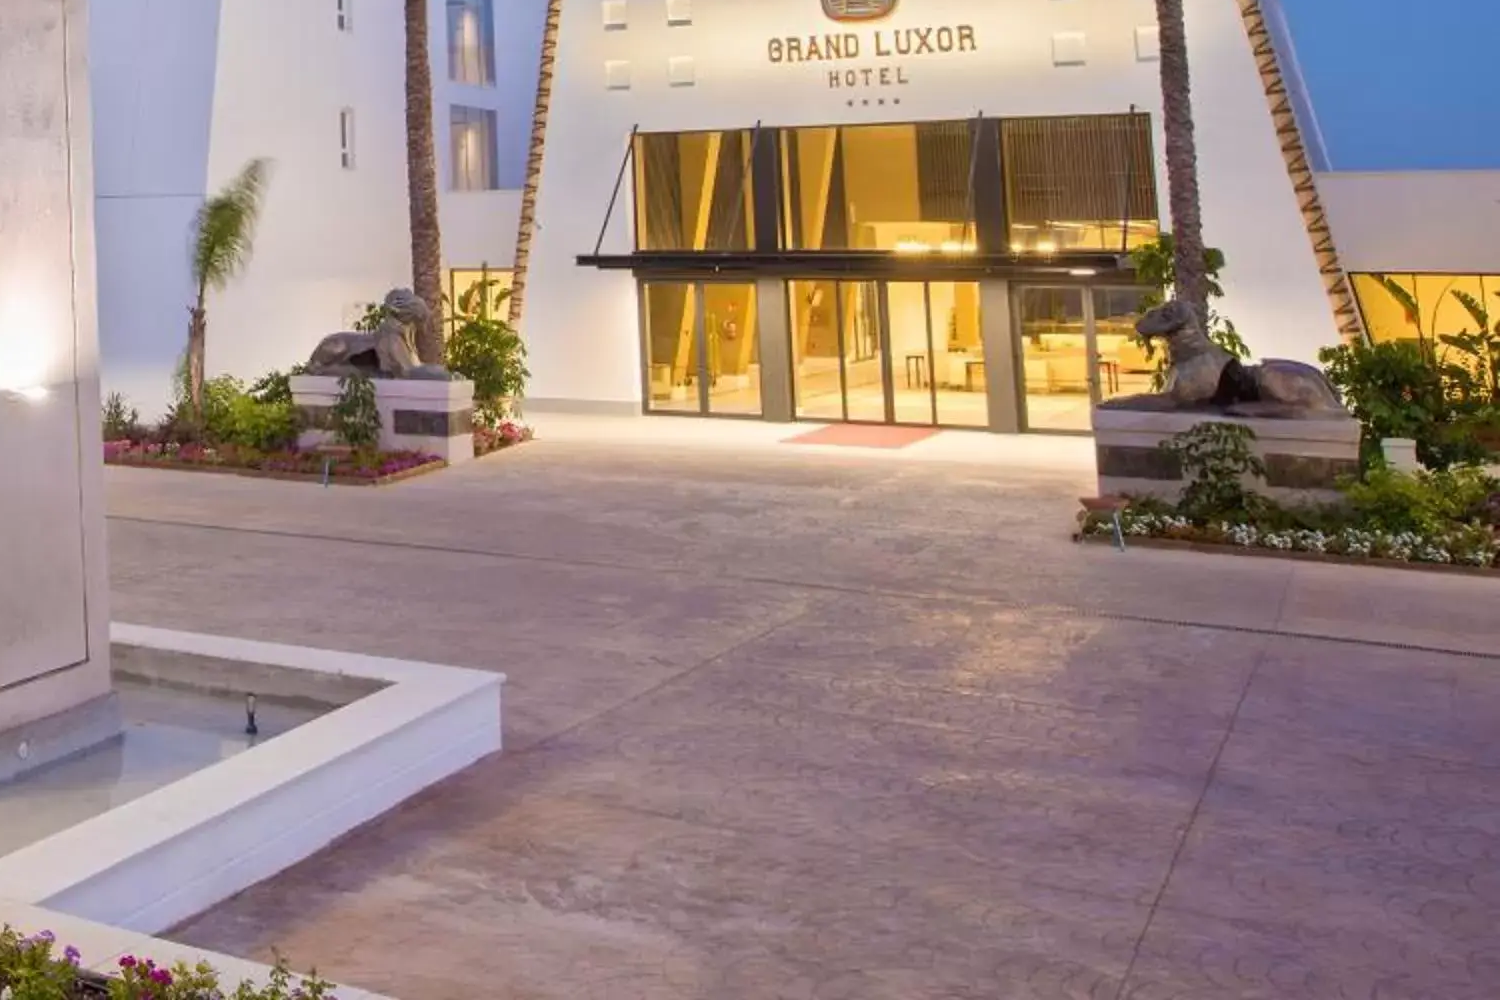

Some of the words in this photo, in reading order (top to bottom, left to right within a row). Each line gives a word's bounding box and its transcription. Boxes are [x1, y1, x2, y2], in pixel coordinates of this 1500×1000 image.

[767, 33, 859, 63] GRAND
[874, 25, 977, 57] LUXOR
[828, 67, 909, 88] HOTEL
